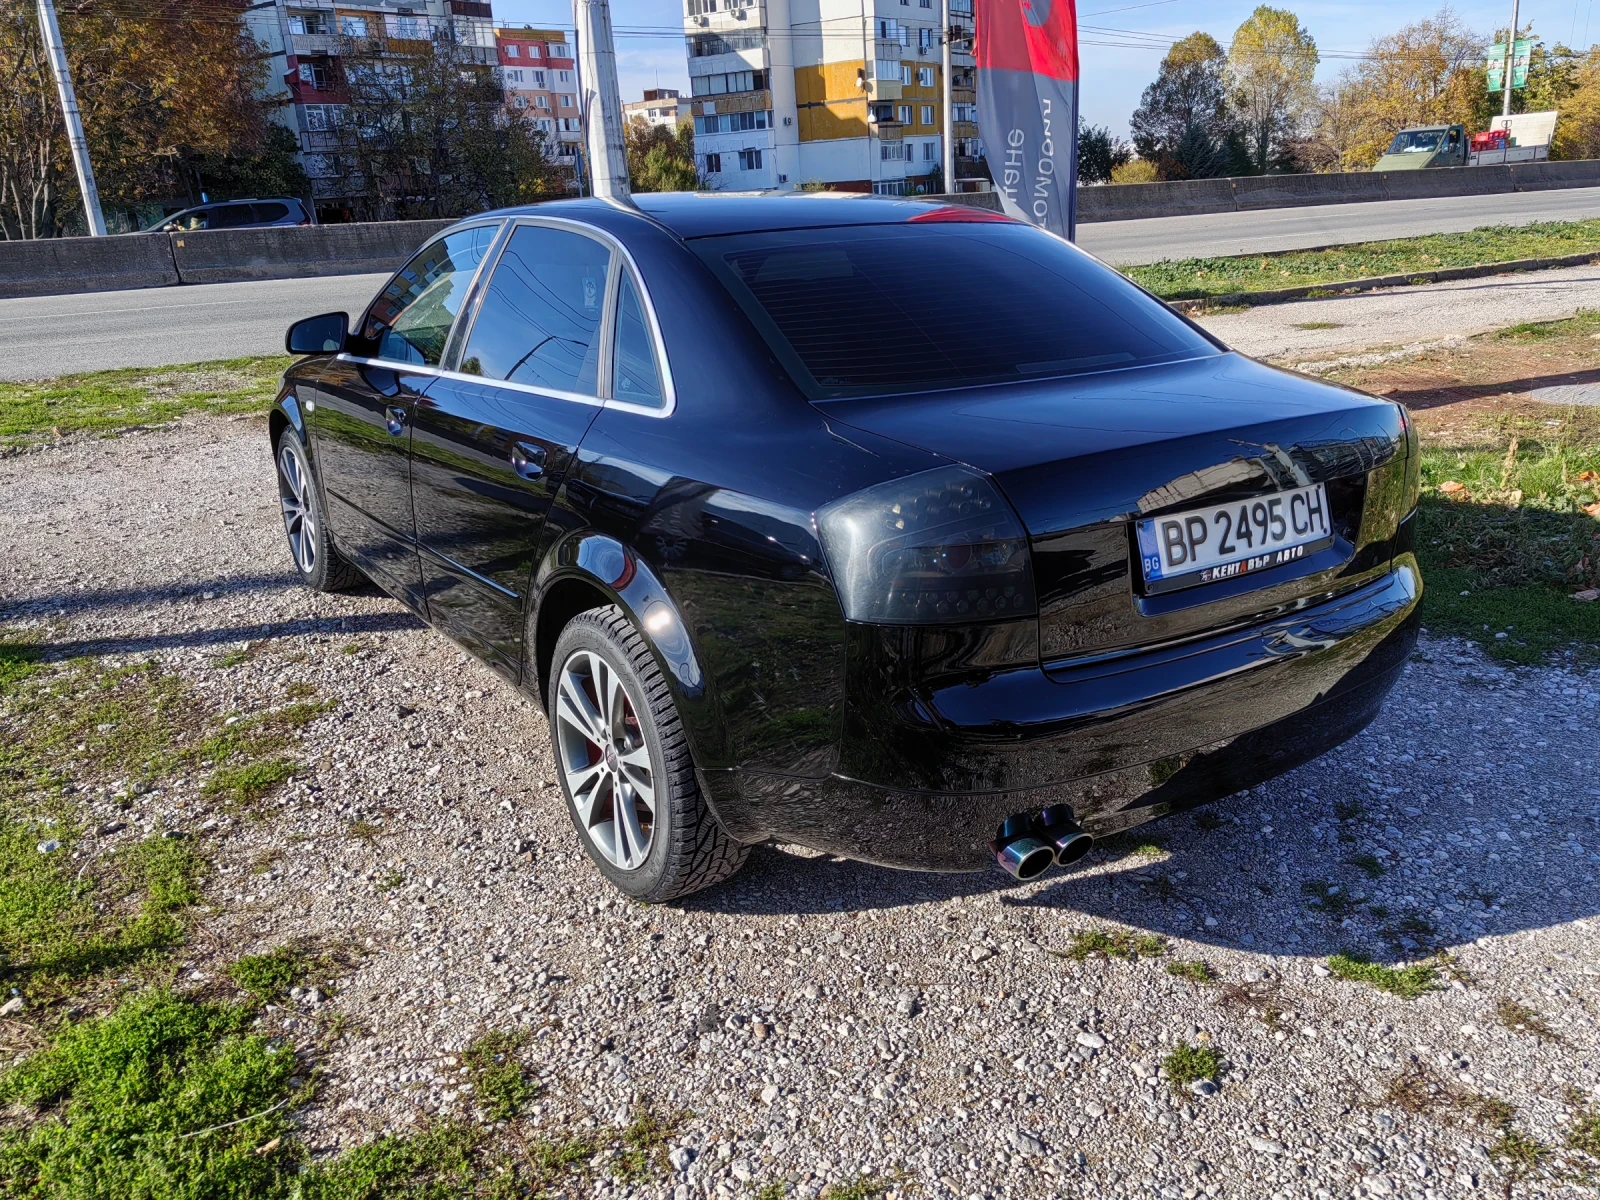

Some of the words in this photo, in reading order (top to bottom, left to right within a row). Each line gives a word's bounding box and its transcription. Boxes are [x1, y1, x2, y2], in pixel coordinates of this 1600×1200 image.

[1162, 515, 1208, 567] BP
[1214, 497, 1287, 556] 2495
[1290, 489, 1325, 536] CH
[1144, 556, 1159, 572] BG
[1212, 555, 1270, 580] КЕНТАВЪР
[1276, 545, 1304, 563] АВТО
